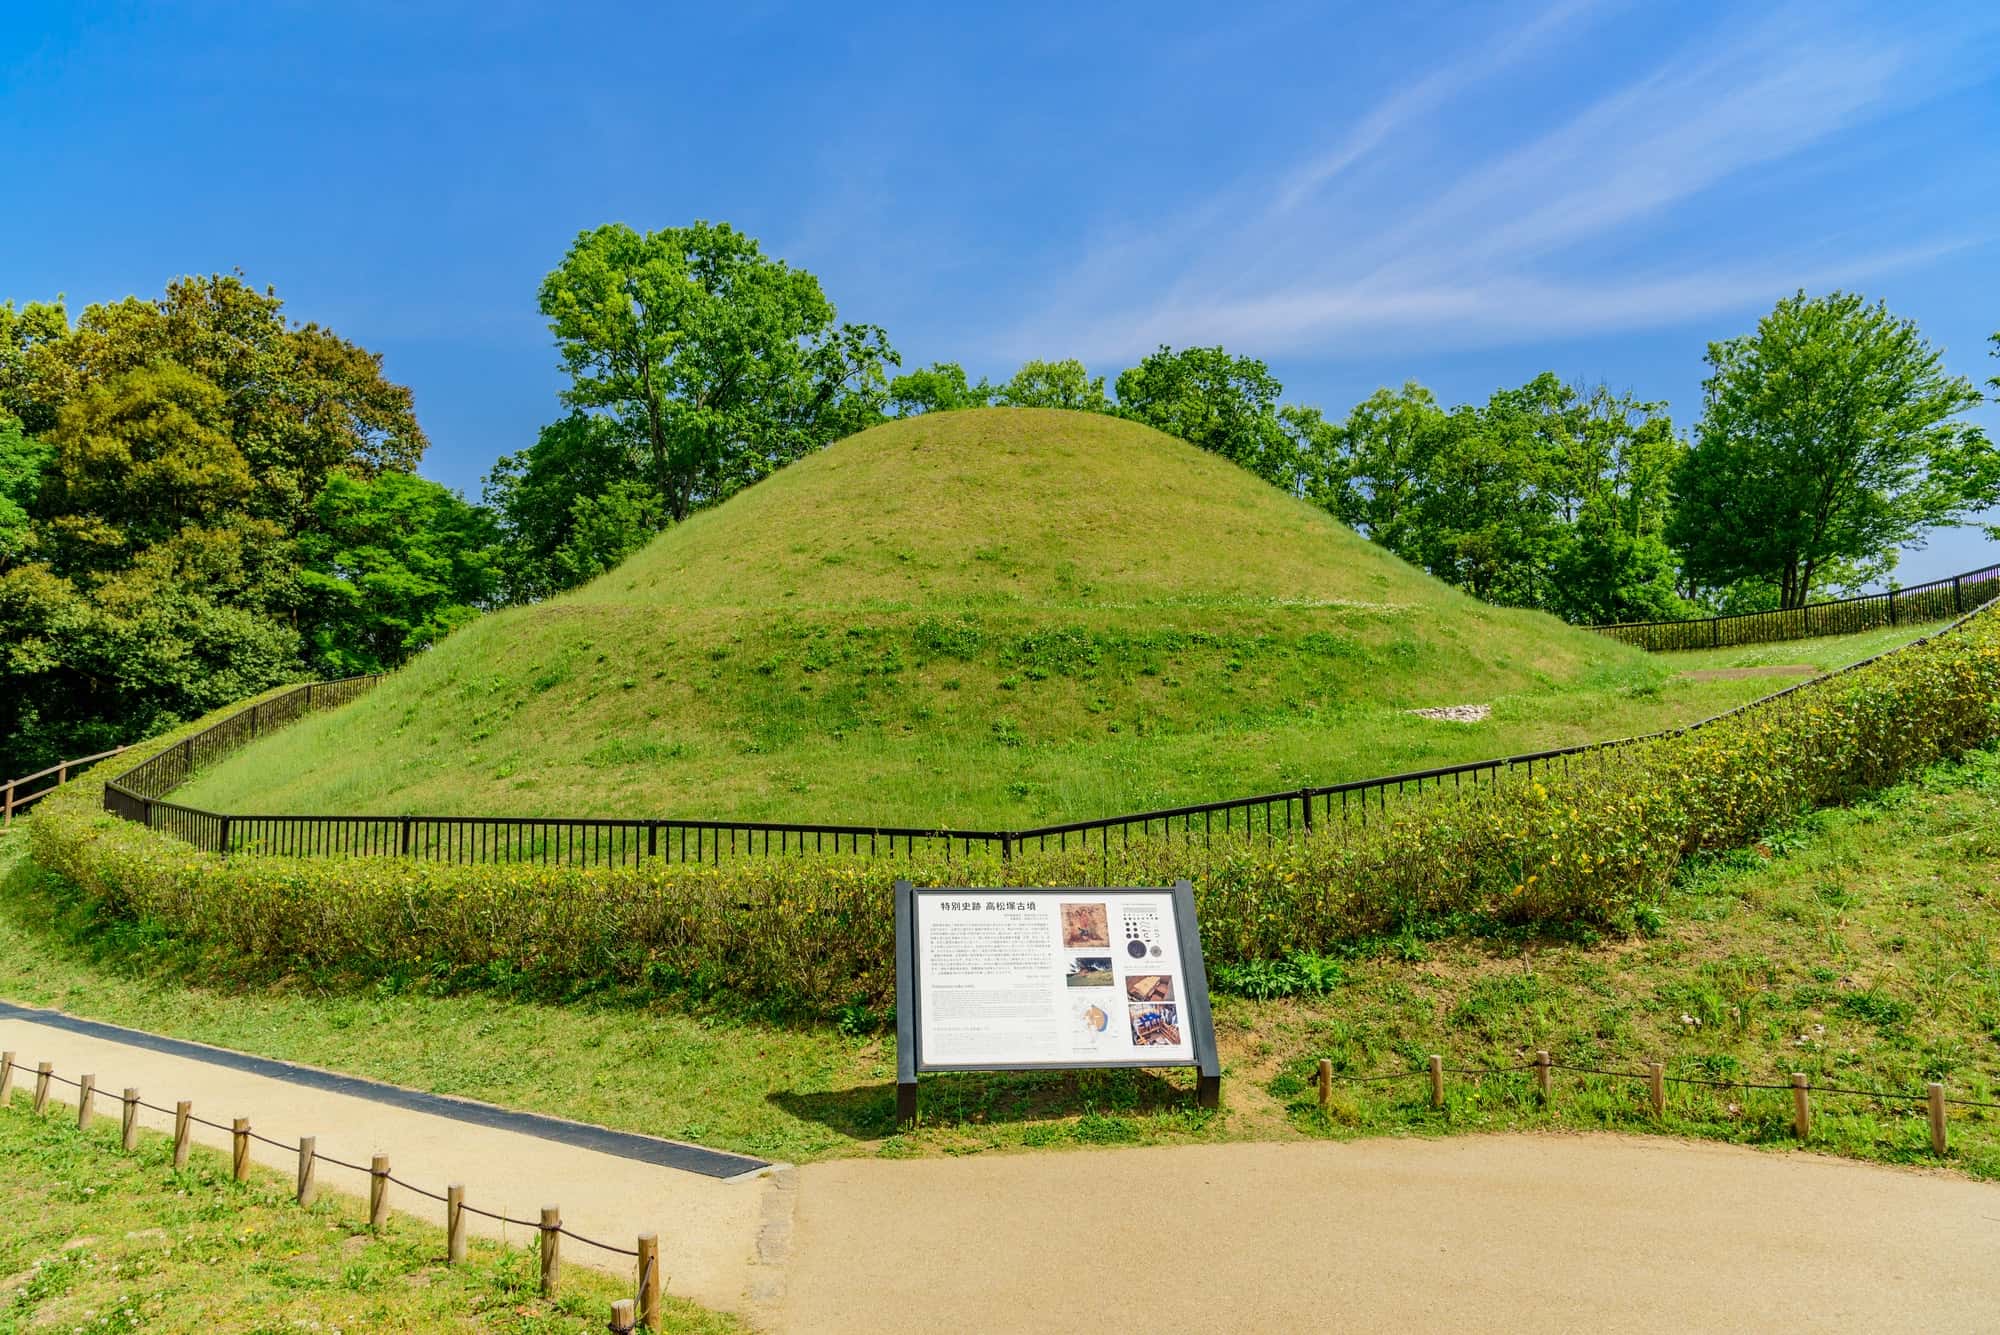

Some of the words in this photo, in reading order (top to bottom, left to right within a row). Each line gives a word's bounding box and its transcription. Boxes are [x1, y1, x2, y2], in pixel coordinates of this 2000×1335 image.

[940, 901, 981, 911] 特別史跡
[985, 901, 1036, 911] 高松塚古墳
